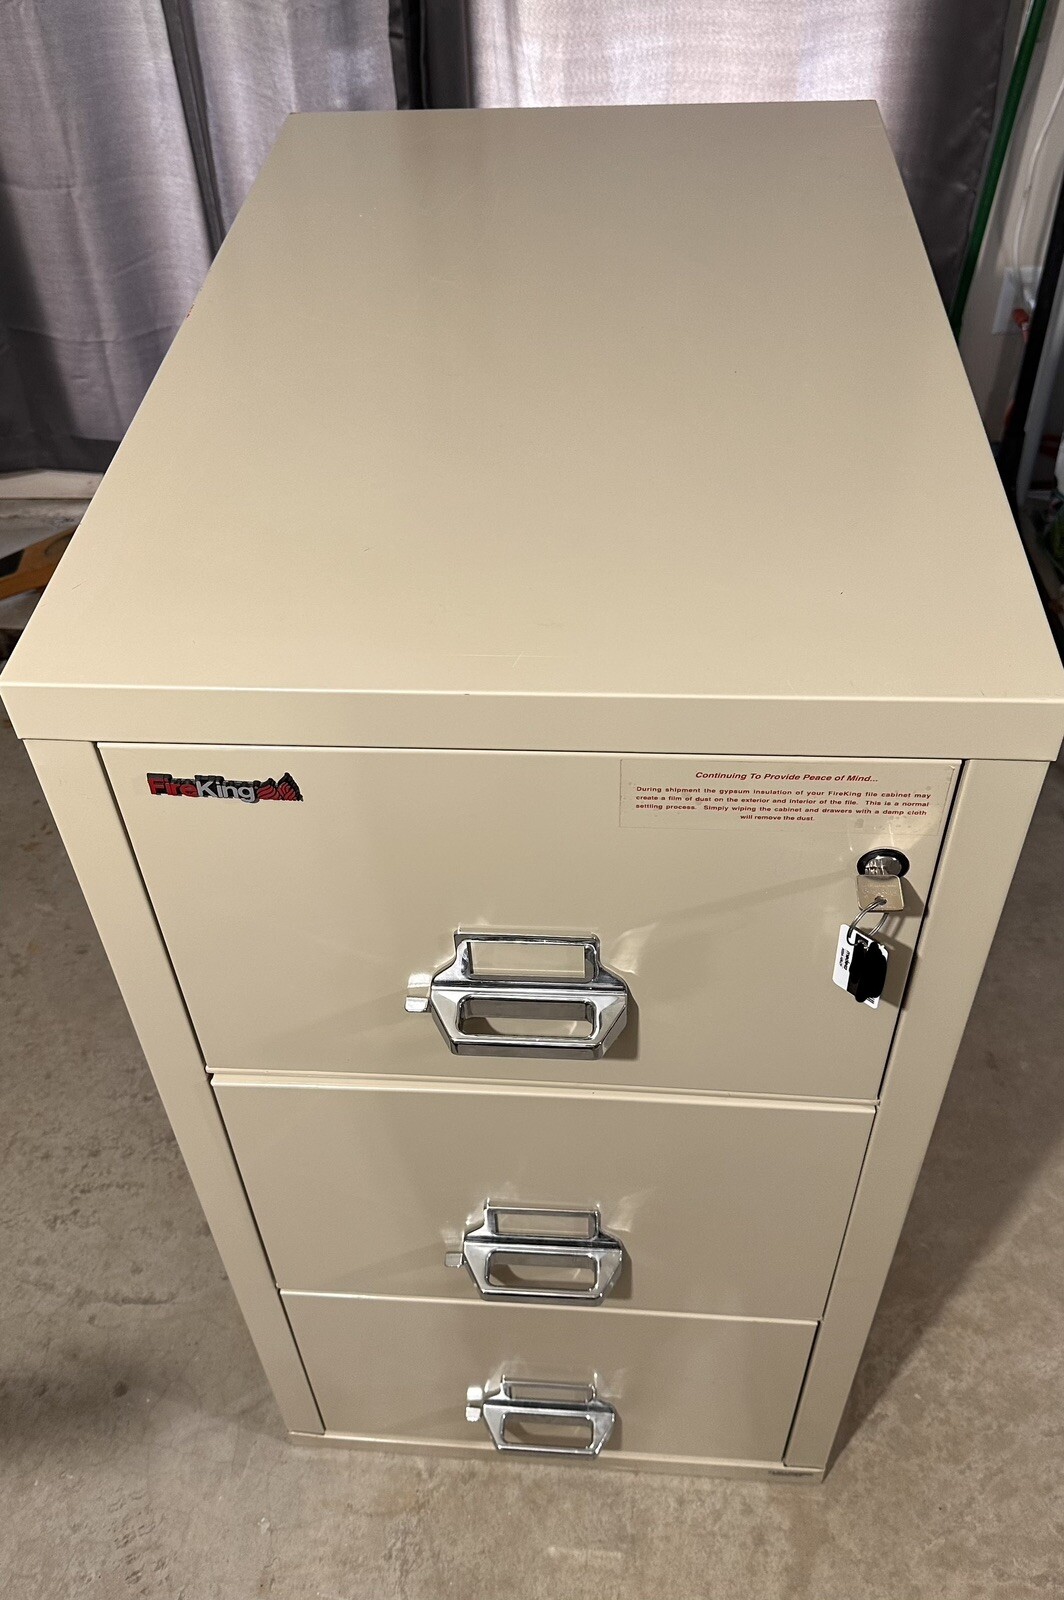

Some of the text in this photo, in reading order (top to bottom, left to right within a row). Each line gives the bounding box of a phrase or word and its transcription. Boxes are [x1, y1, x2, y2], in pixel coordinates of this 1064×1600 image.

[695, 771, 747, 780] Continuing
[750, 772, 761, 780] To
[763, 772, 801, 781] Provide
[148, 774, 257, 803] FireKing
[827, 790, 862, 798] FireKing
